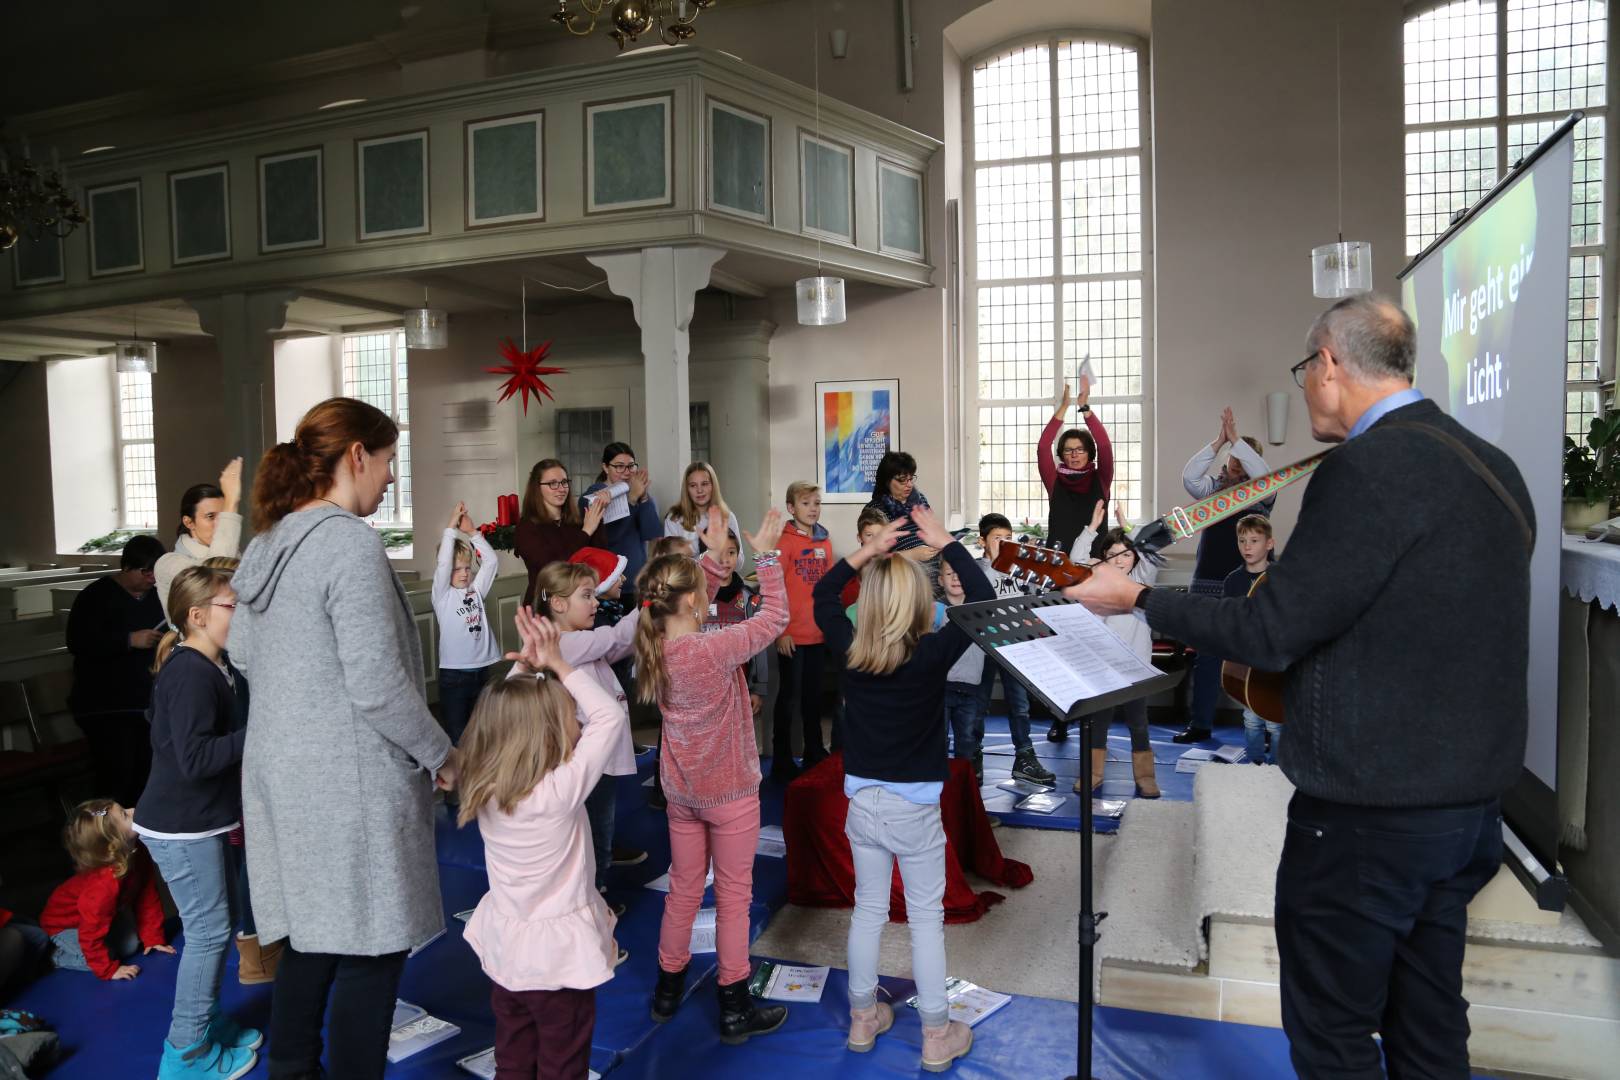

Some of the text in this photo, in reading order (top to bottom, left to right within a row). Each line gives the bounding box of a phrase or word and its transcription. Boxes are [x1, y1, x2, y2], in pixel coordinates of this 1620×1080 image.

[1444, 289, 1467, 339] Mir
[1470, 265, 1504, 336] geht
[1466, 352, 1503, 405] Licht
